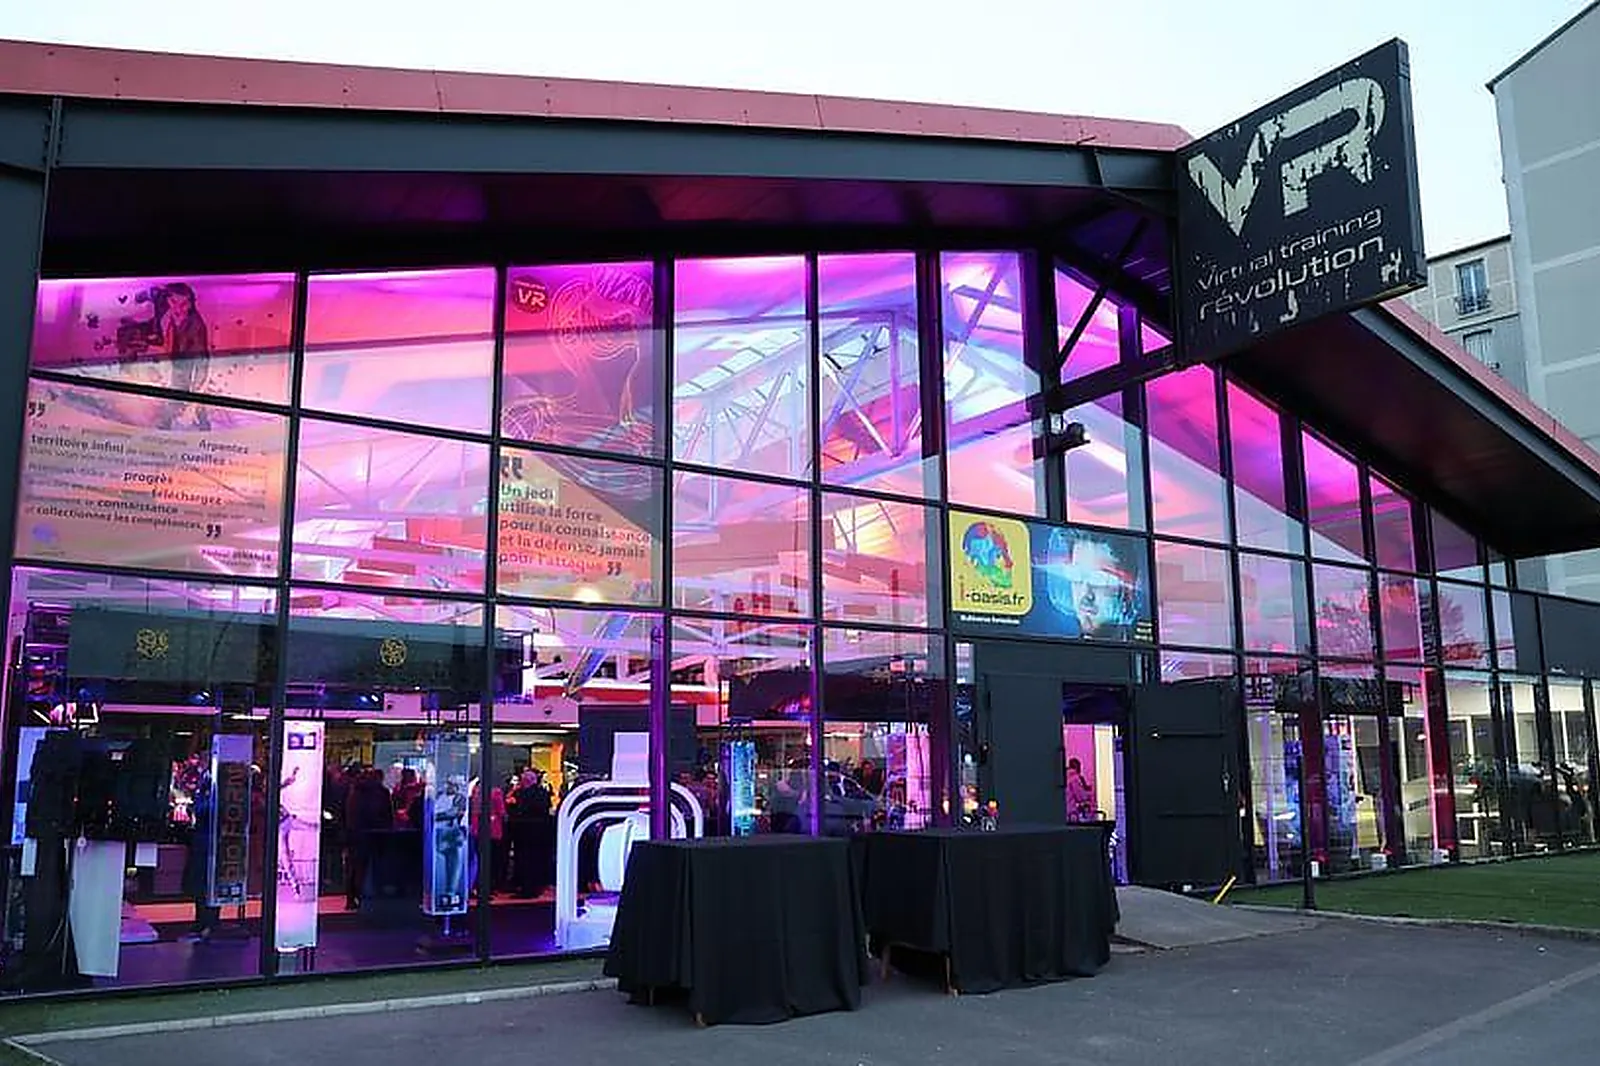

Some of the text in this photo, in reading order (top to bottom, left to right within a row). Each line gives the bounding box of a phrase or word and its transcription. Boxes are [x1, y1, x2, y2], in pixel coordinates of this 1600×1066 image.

[1280, 209, 1382, 259] training
[518, 288, 545, 307] VR
[31, 433, 88, 450] territoire
[91, 440, 124, 454] infini
[501, 483, 553, 500] Un jedi
[500, 501, 600, 521] utilise la force
[500, 519, 534, 534] pour
[555, 523, 651, 544] connaissance
[498, 552, 532, 565] pour
[599, 545, 645, 558] jamais
